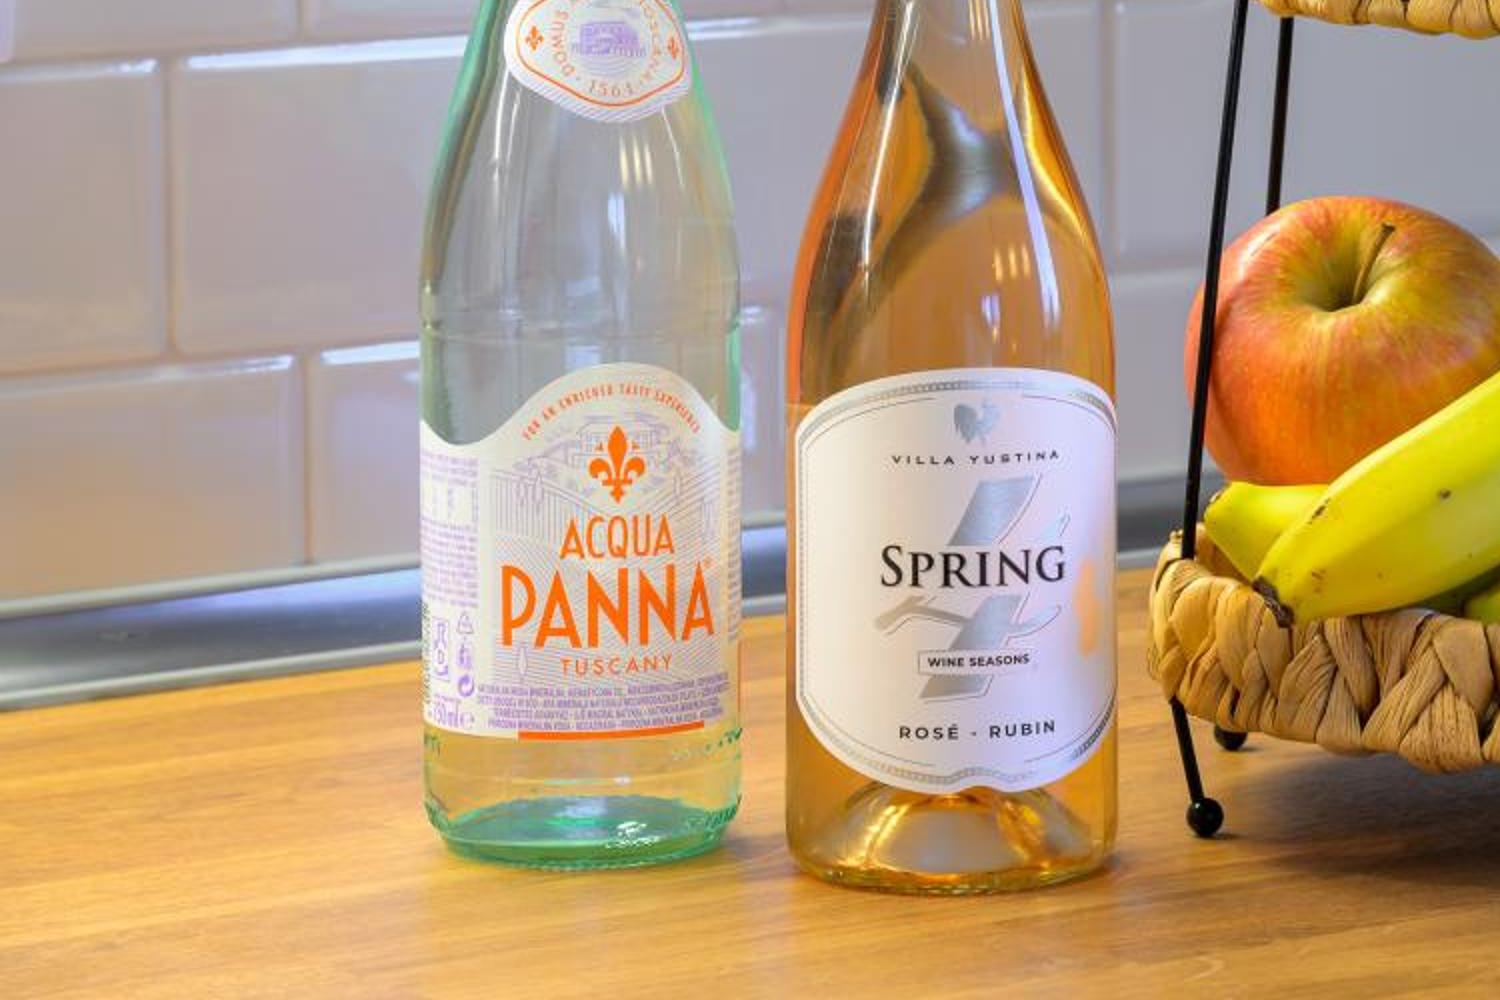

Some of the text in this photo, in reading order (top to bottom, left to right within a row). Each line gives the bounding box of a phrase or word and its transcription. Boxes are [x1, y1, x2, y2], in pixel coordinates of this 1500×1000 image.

[551, 9, 576, 77] DOMUS
[891, 449, 1059, 465] VILLA YUSTINA
[559, 513, 675, 559] ACQUA
[880, 544, 1066, 588] SPRING
[501, 561, 715, 649] PANNA
[560, 654, 673, 676] TUSCANY
[927, 653, 1031, 667] WINE SEASONS
[899, 723, 959, 740] ROSÉ
[989, 720, 1055, 739] RUBIN
